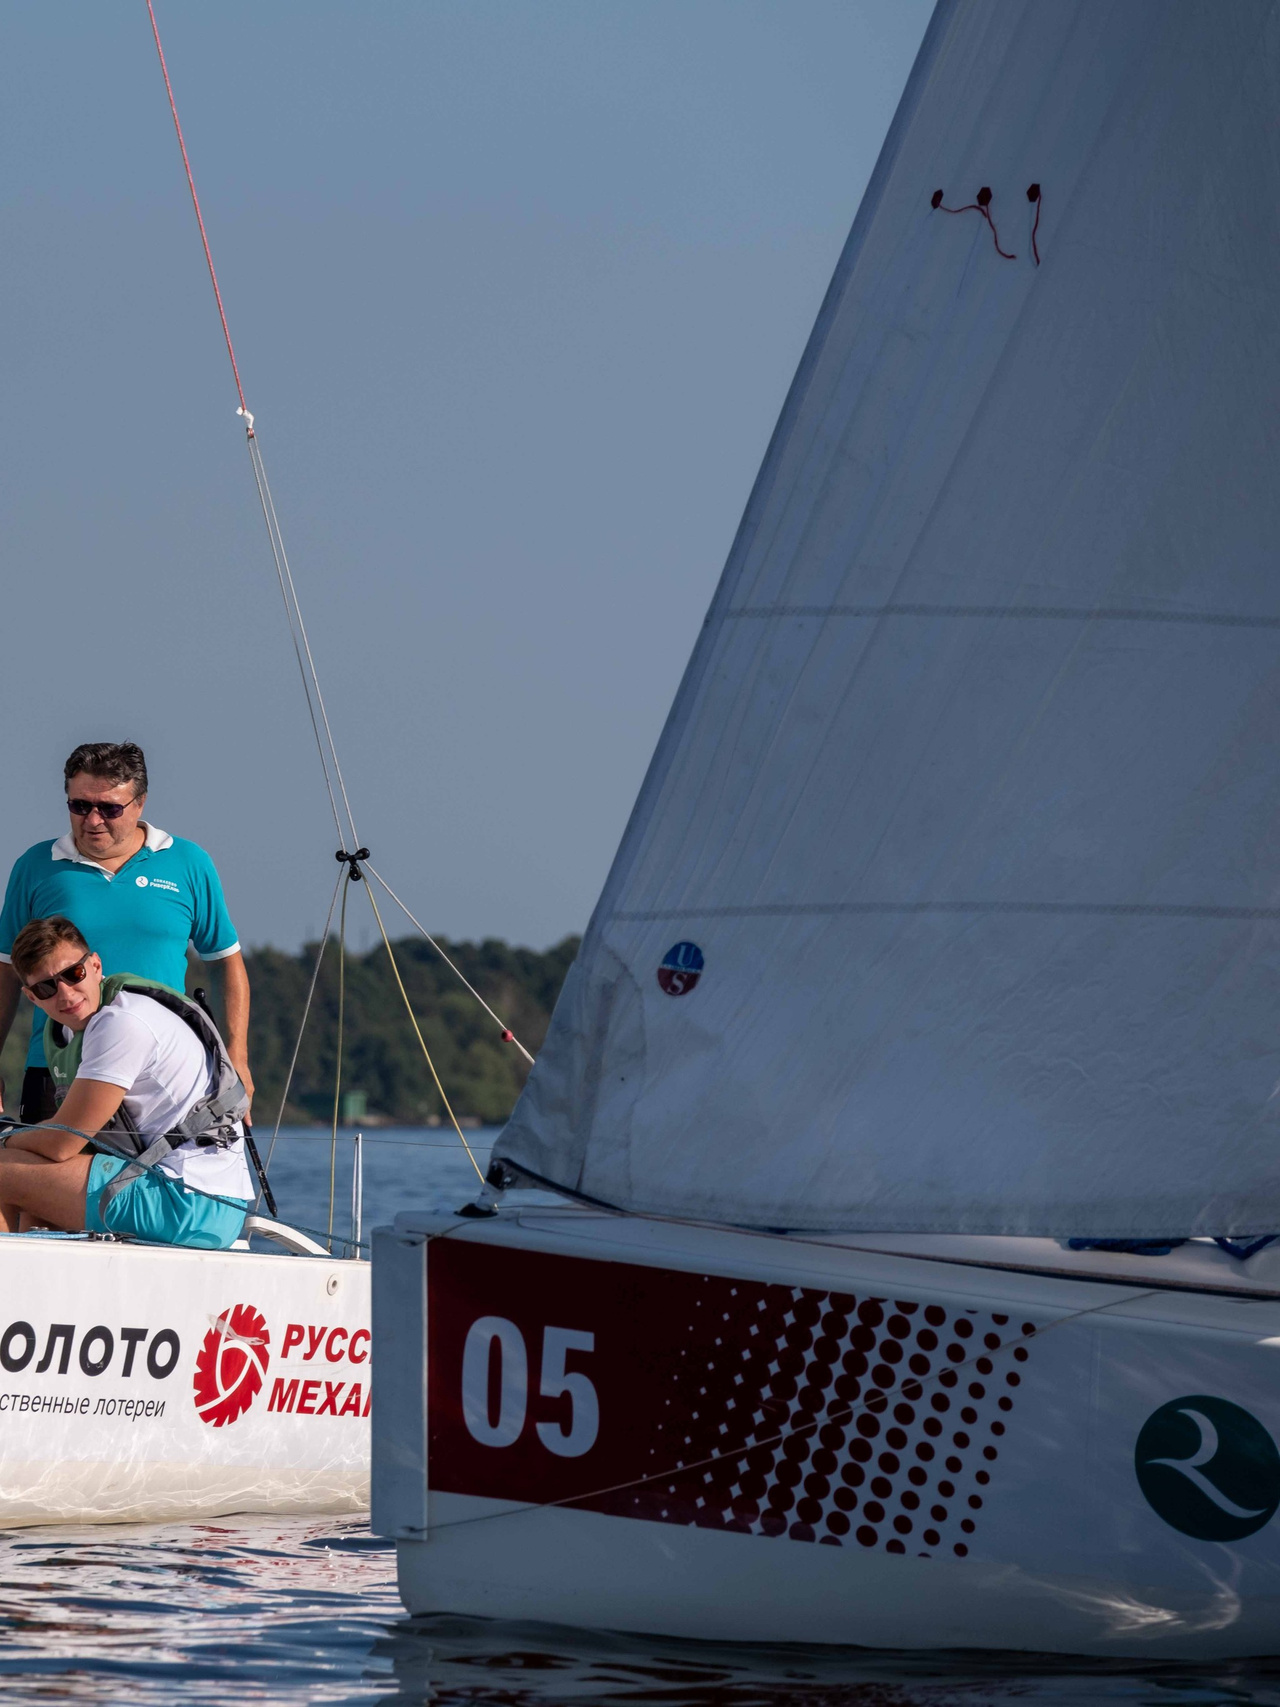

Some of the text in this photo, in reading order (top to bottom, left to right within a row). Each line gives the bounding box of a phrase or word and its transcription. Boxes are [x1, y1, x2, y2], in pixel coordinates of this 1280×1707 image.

[280, 1323, 371, 1365] РУСС
[461, 1315, 600, 1458] 05
[93, 1397, 166, 1422] лотереи
